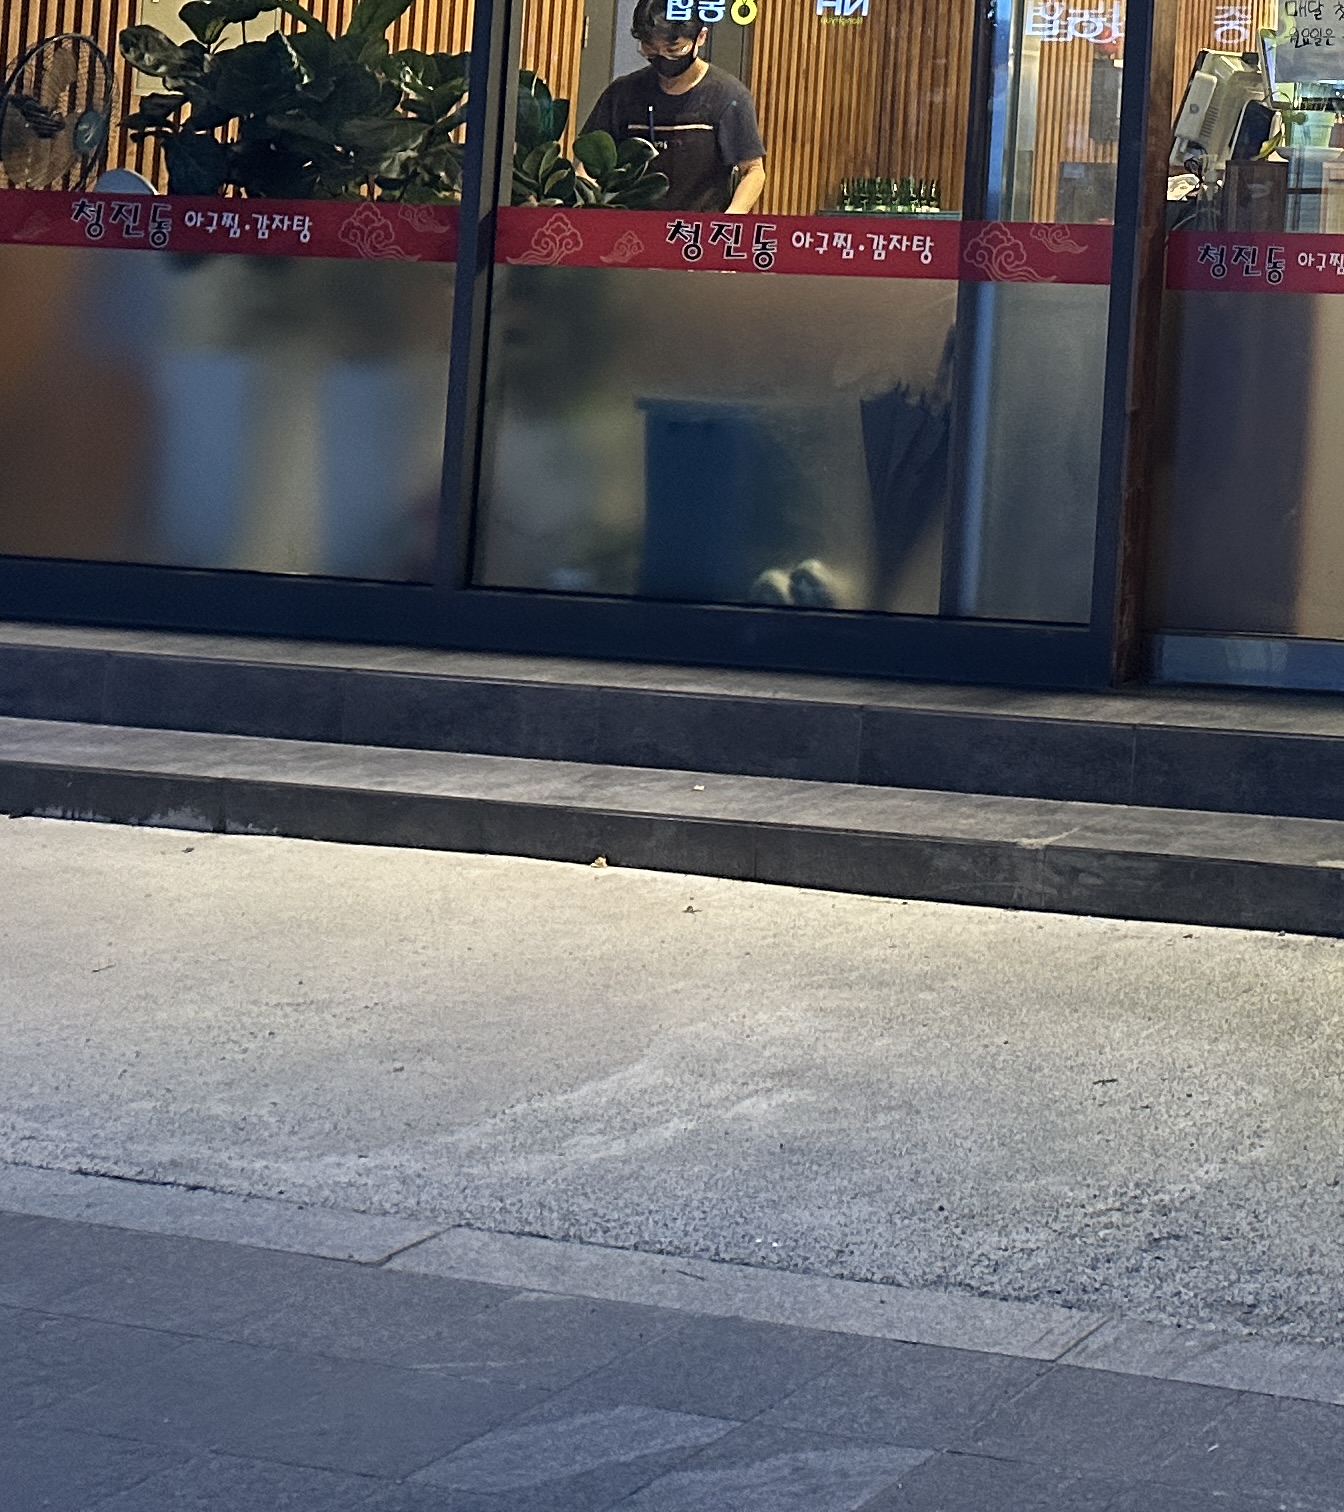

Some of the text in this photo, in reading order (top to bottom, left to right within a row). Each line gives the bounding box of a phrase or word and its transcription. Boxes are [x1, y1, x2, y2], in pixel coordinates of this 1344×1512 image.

[70, 199, 174, 249] 청진동
[666, 219, 778, 271] 청진동
[1198, 244, 1286, 285] 청진동
